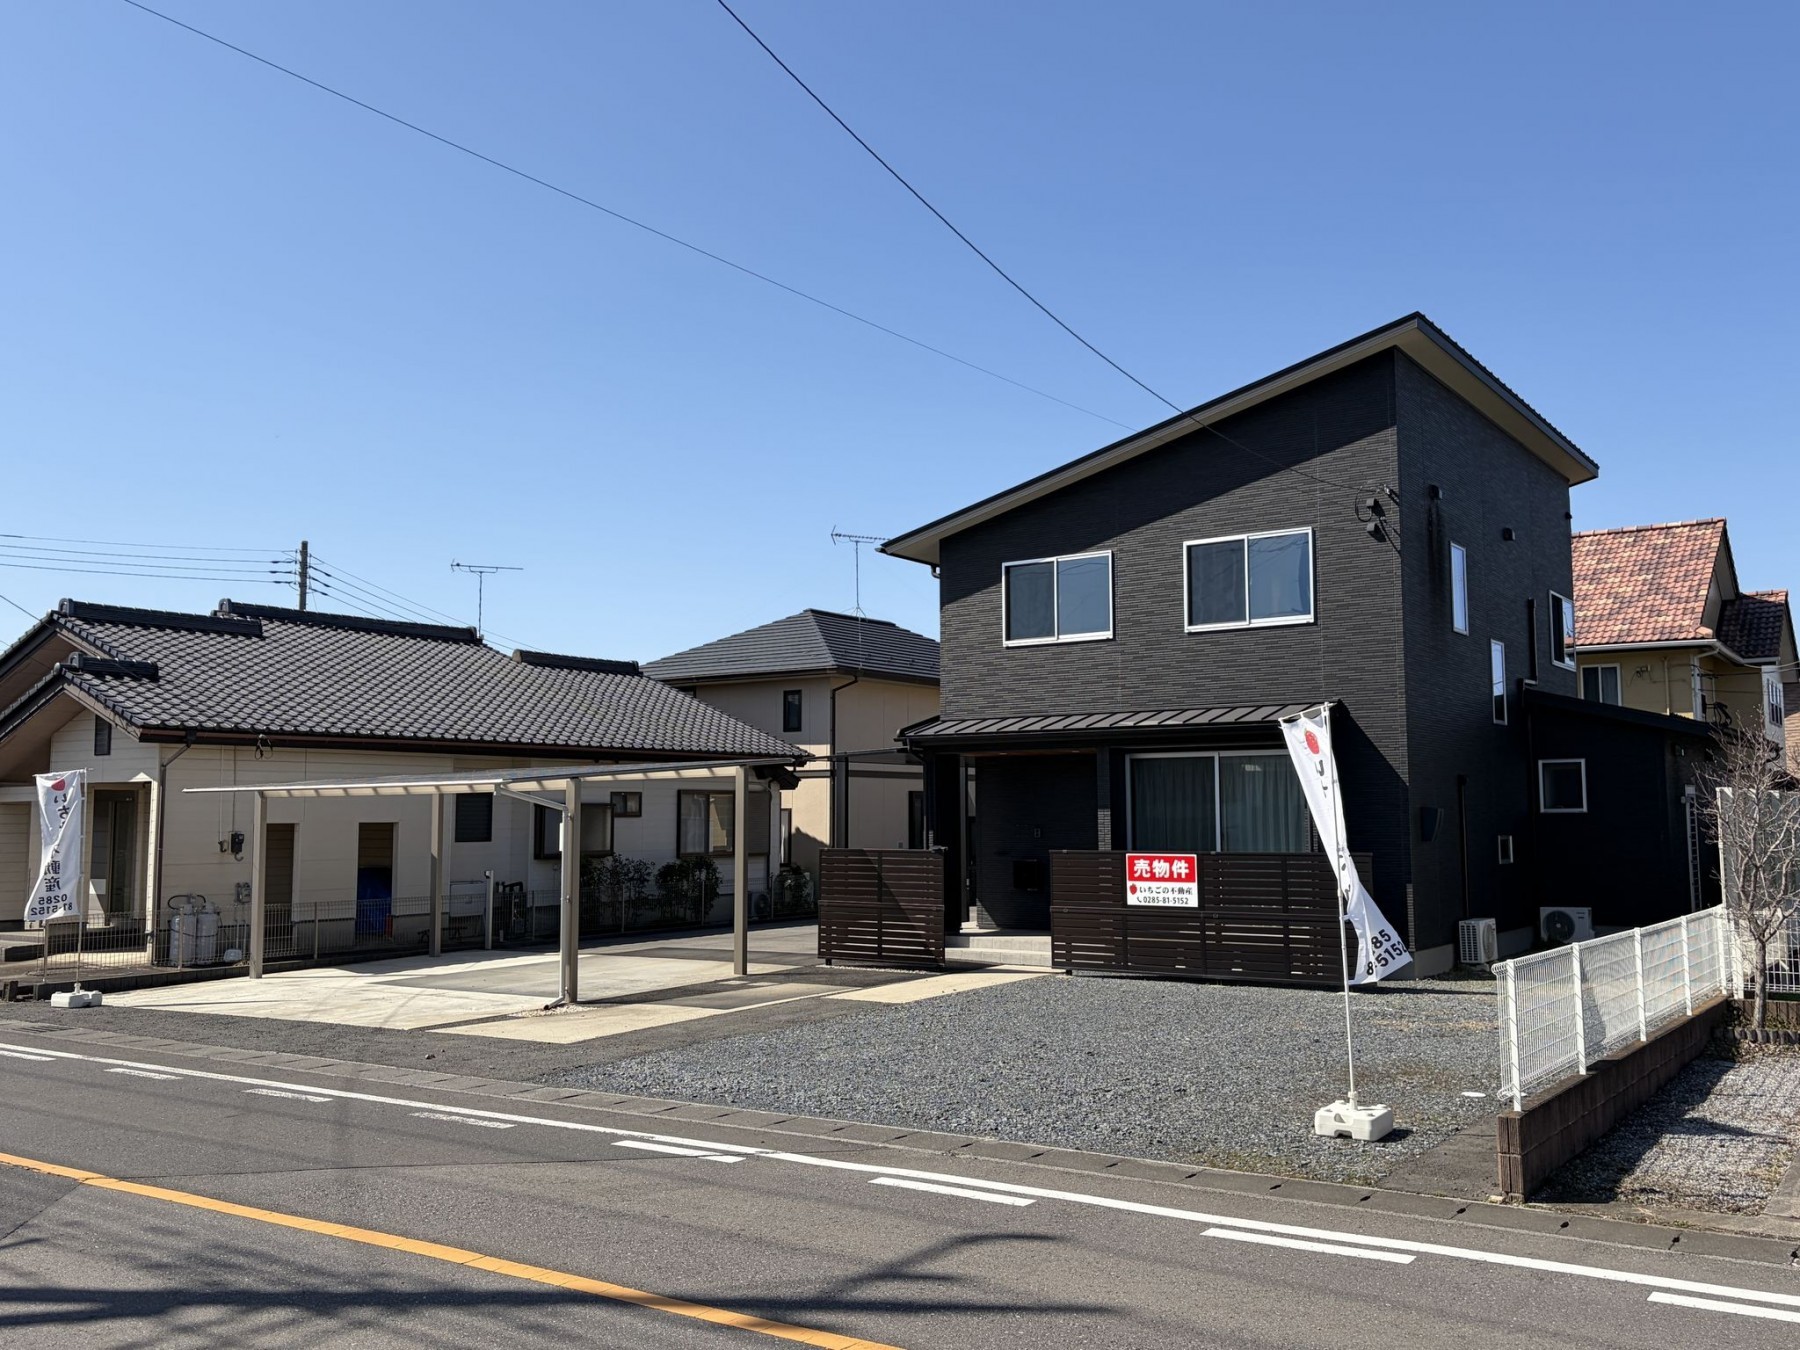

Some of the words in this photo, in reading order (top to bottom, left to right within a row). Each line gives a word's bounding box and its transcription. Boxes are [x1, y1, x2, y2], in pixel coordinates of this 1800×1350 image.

[1134, 858, 1189, 878] 売物件
[1139, 886, 1192, 895] いちごの不動産
[1143, 896, 1188, 904] 0285-81-5152
